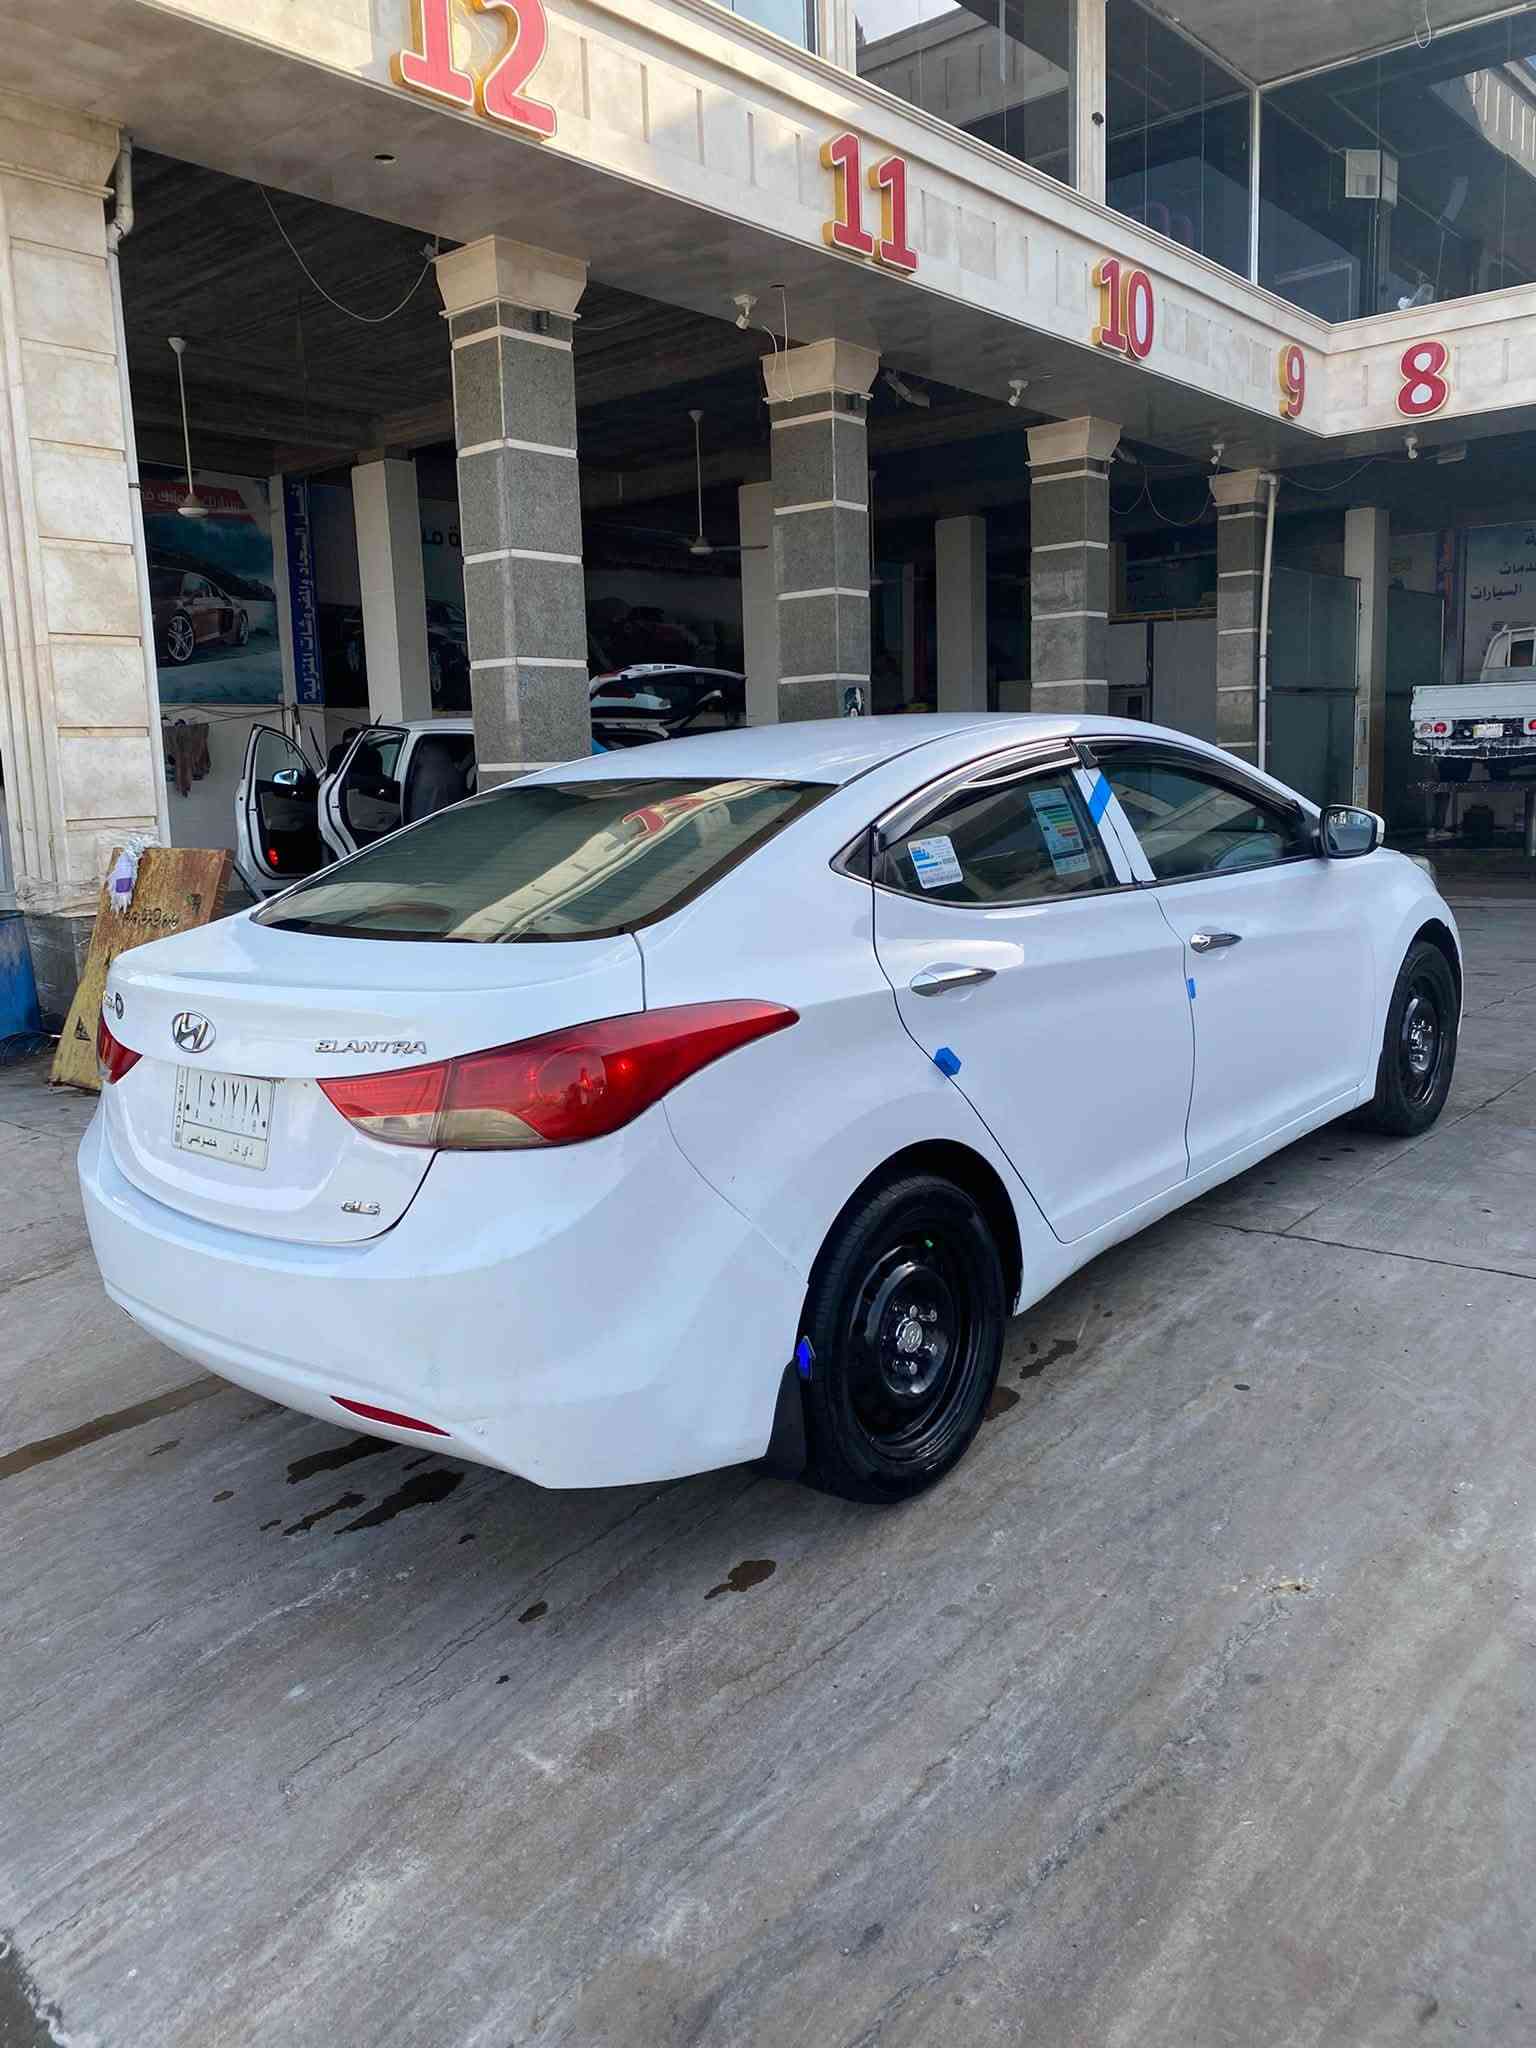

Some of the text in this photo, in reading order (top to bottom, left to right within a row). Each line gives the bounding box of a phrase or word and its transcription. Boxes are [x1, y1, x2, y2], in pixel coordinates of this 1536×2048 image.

[391, 0, 557, 141] 12
[820, 130, 918, 273] 11
[1092, 256, 1156, 361] 10
[1279, 343, 1306, 419] 9
[1396, 340, 1450, 419] 8
[1471, 584, 1522, 601] السيارات
[315, 1039, 427, 1056] ELANTRA
